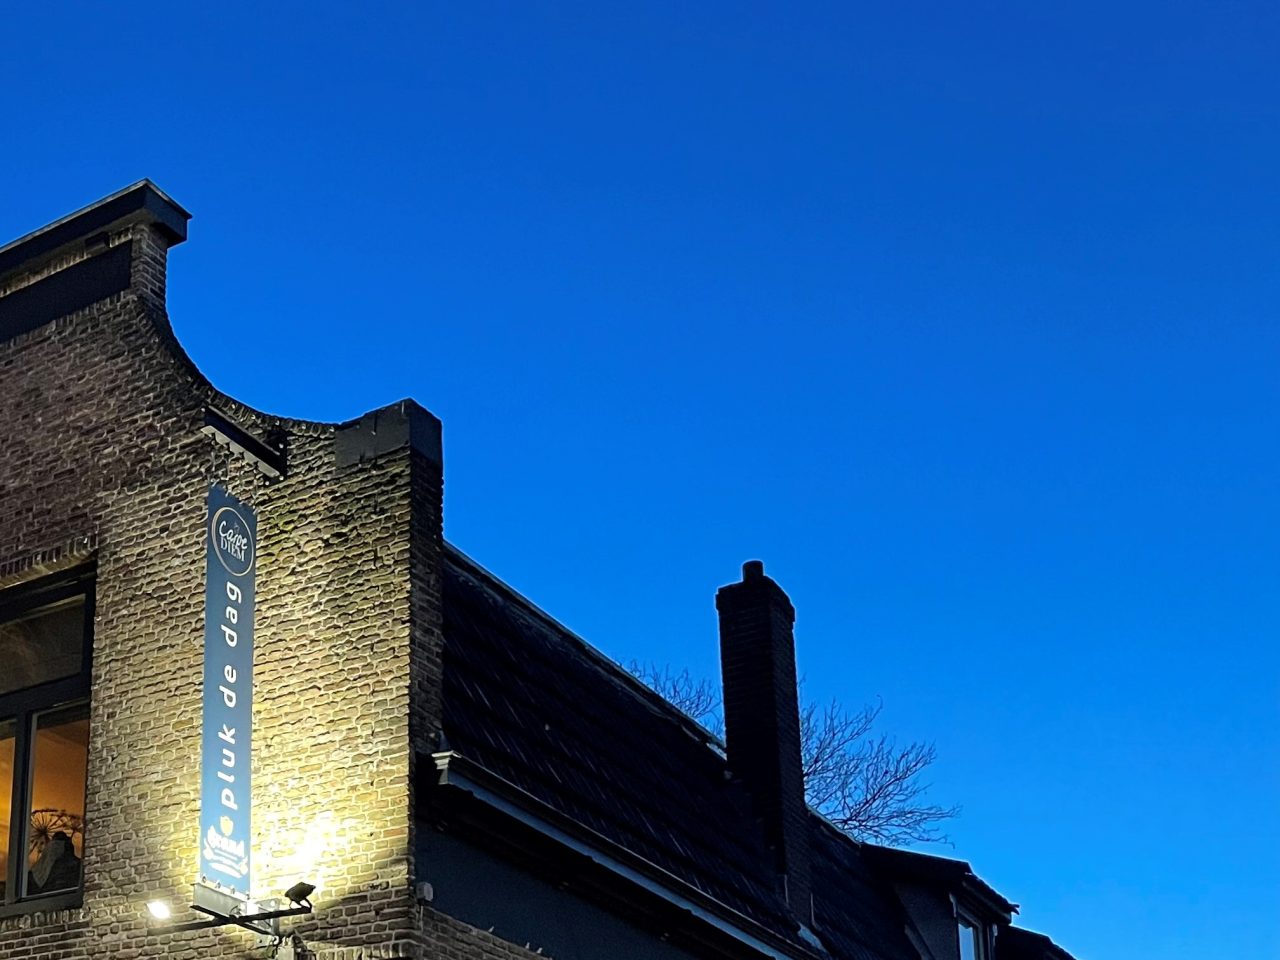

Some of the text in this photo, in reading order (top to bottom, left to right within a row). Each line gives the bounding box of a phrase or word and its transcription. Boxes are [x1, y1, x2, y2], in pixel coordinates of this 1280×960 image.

[219, 520, 248, 550] Carpe
[220, 580, 242, 648] dag
[219, 664, 237, 708] de
[217, 723, 238, 811] pluk
